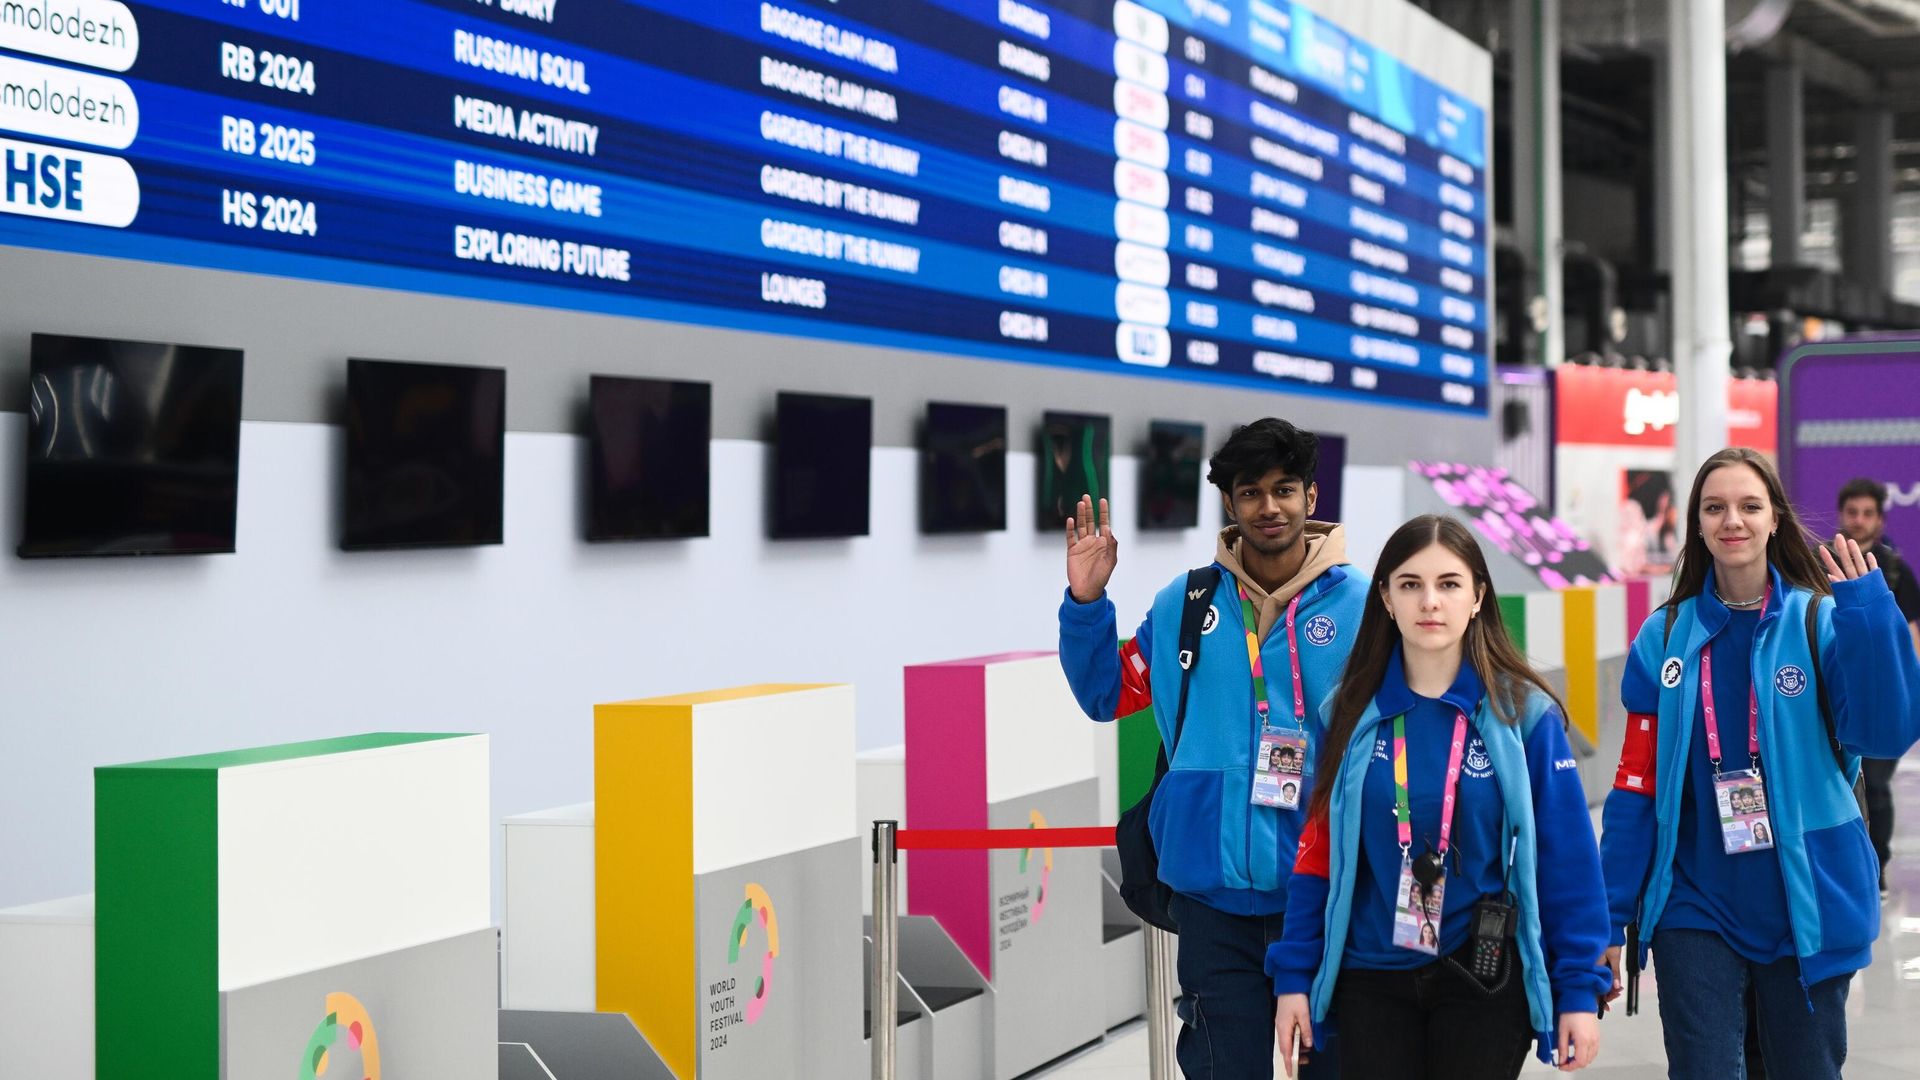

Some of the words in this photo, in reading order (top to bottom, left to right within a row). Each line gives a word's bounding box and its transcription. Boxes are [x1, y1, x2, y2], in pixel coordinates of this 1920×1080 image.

[0, 0, 126, 49] molodezh
[222, 42, 256, 82] RB
[259, 51, 315, 95] 2024
[454, 28, 539, 82] RUSSIAN
[540, 51, 591, 95] SOUL
[0, 80, 126, 126] molodezh
[454, 94, 516, 140] MEDIA
[517, 110, 599, 156] ACTIVITY
[222, 115, 256, 155] RB
[259, 123, 316, 166] 2025
[6, 149, 83, 211] HSE
[454, 159, 549, 208] BUSINESS
[550, 178, 602, 217] GAME
[222, 189, 257, 228] HS
[261, 195, 317, 236] 2024
[455, 224, 561, 271] EXPLORING
[562, 241, 631, 282] FUTURE
[709, 977, 736, 997] WORLD
[709, 996, 735, 1015] YOUTH
[710, 1010, 744, 1033] FESTIVAL
[710, 1033, 728, 1051] 2024
